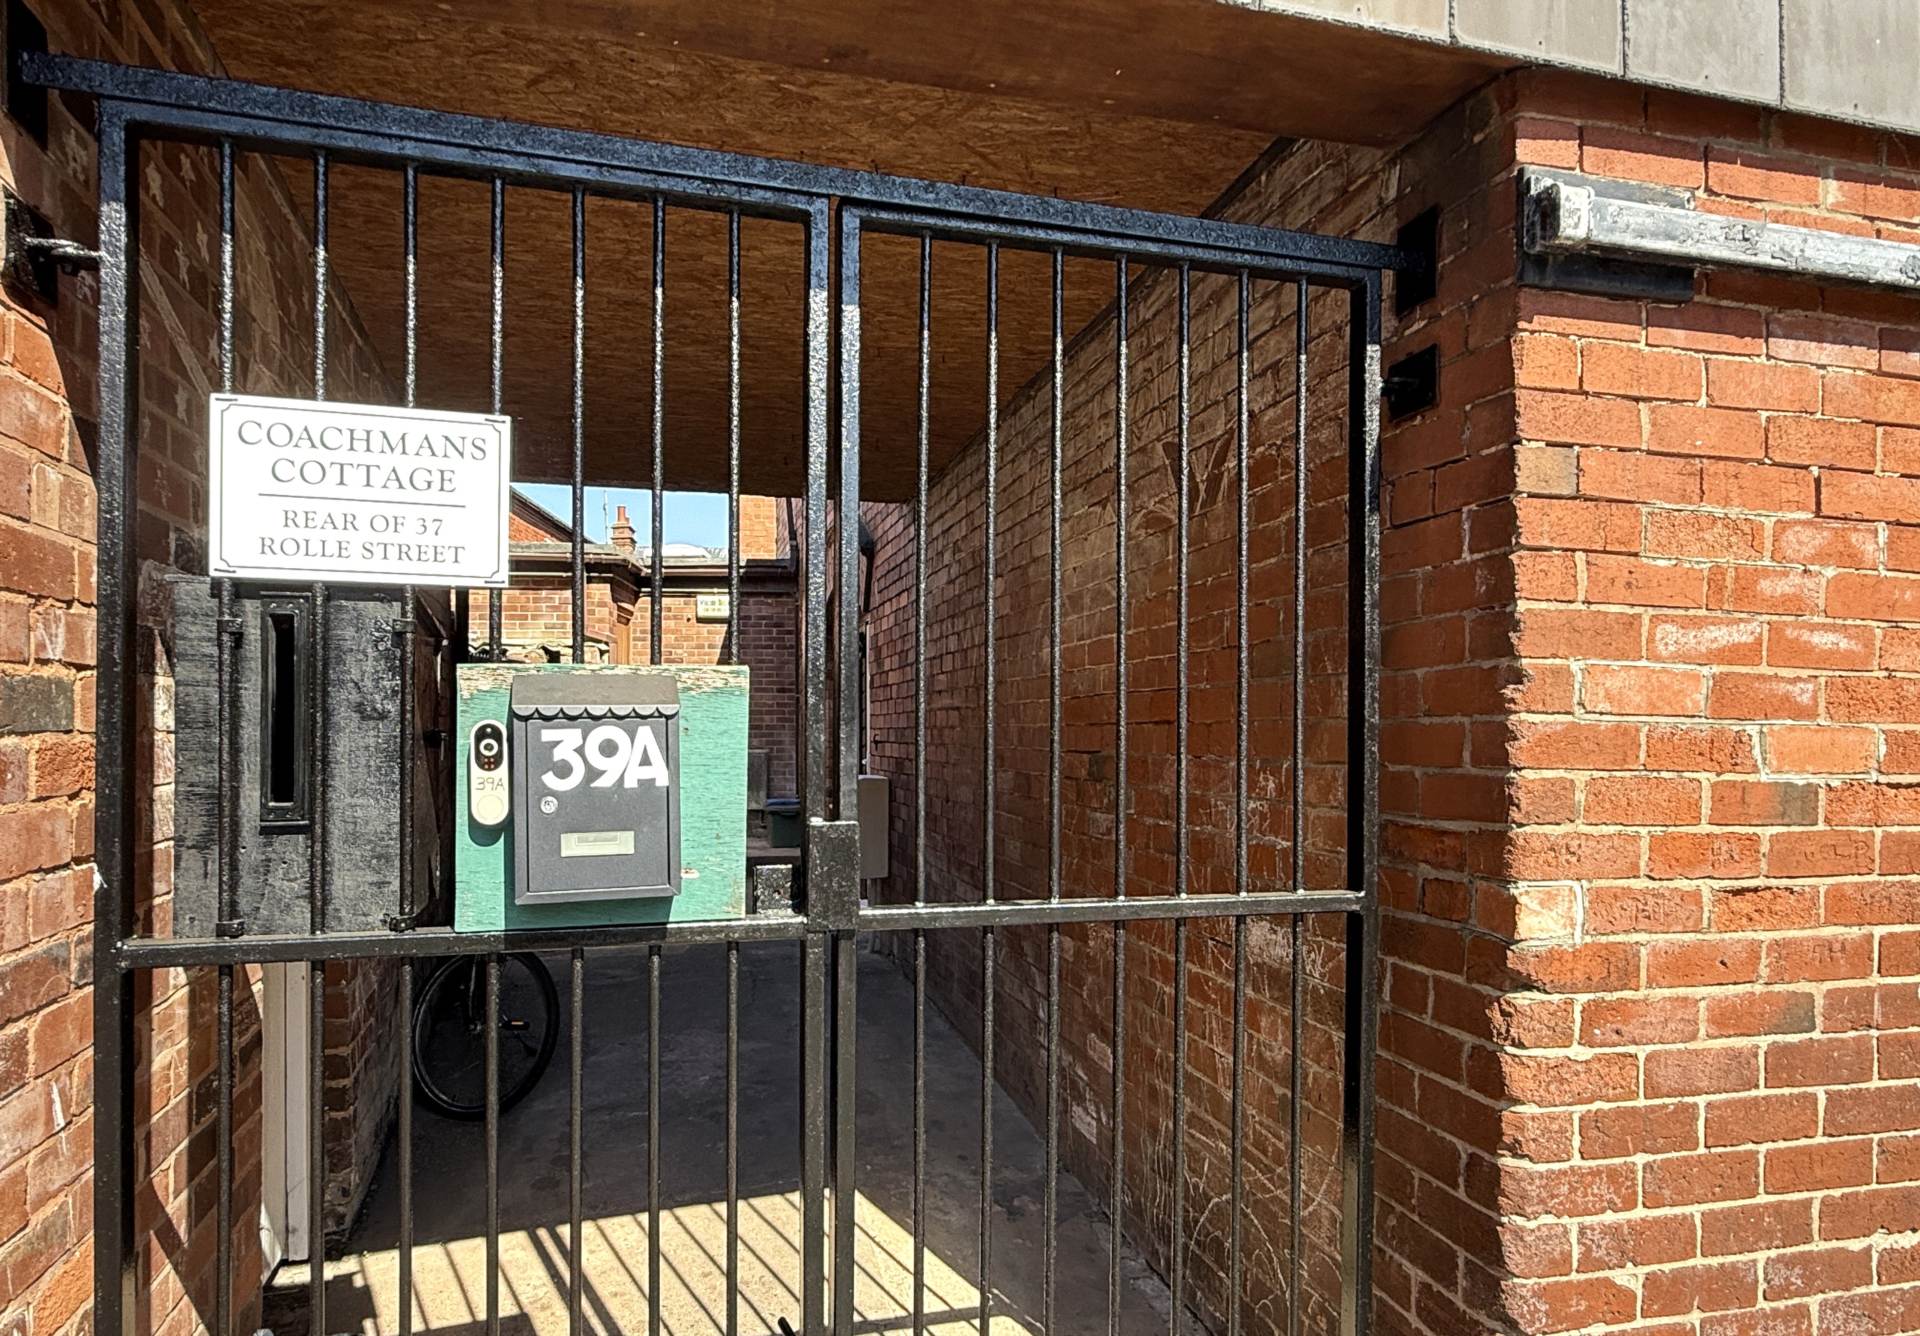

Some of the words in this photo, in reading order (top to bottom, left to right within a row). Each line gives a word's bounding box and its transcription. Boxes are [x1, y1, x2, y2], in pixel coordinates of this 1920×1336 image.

[238, 420, 487, 460] COACHMANS
[271, 458, 457, 493] COTTAGE
[283, 509, 359, 531] REAR
[370, 514, 406, 533] OF
[415, 517, 443, 536] 37
[259, 536, 351, 559] ROLLE
[361, 541, 466, 564] STREET
[541, 725, 670, 791] 39A
[475, 776, 505, 791] 39A
